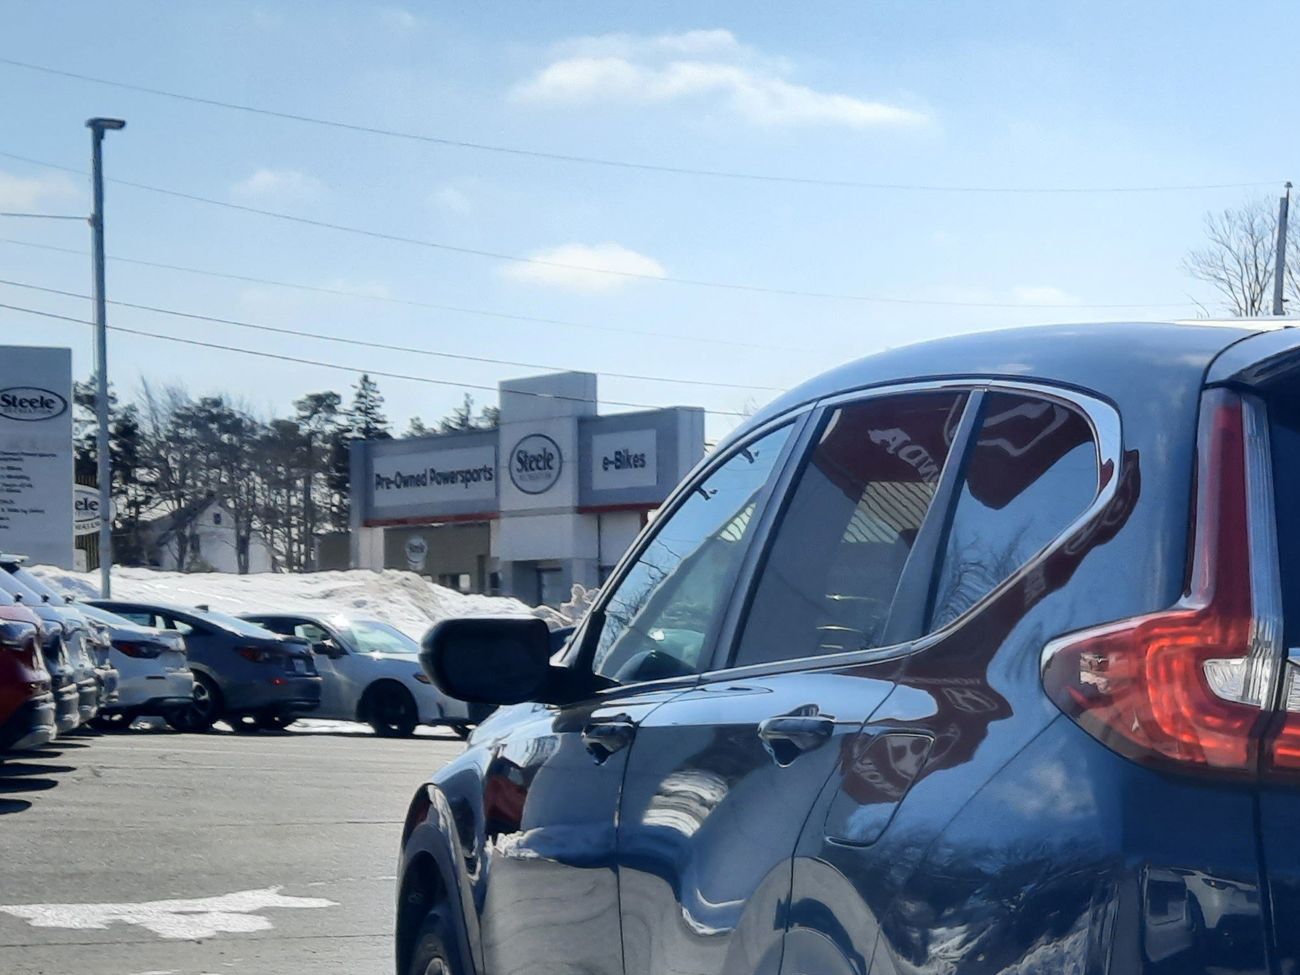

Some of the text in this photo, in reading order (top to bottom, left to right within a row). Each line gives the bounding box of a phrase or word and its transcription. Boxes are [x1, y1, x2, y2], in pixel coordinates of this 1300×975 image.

[0, 393, 55, 409] Steele
[516, 447, 555, 473] Steele
[602, 448, 646, 471] e-Bikes
[375, 464, 493, 490] Pre-Owned Powersports
[74, 498, 99, 511] ele
